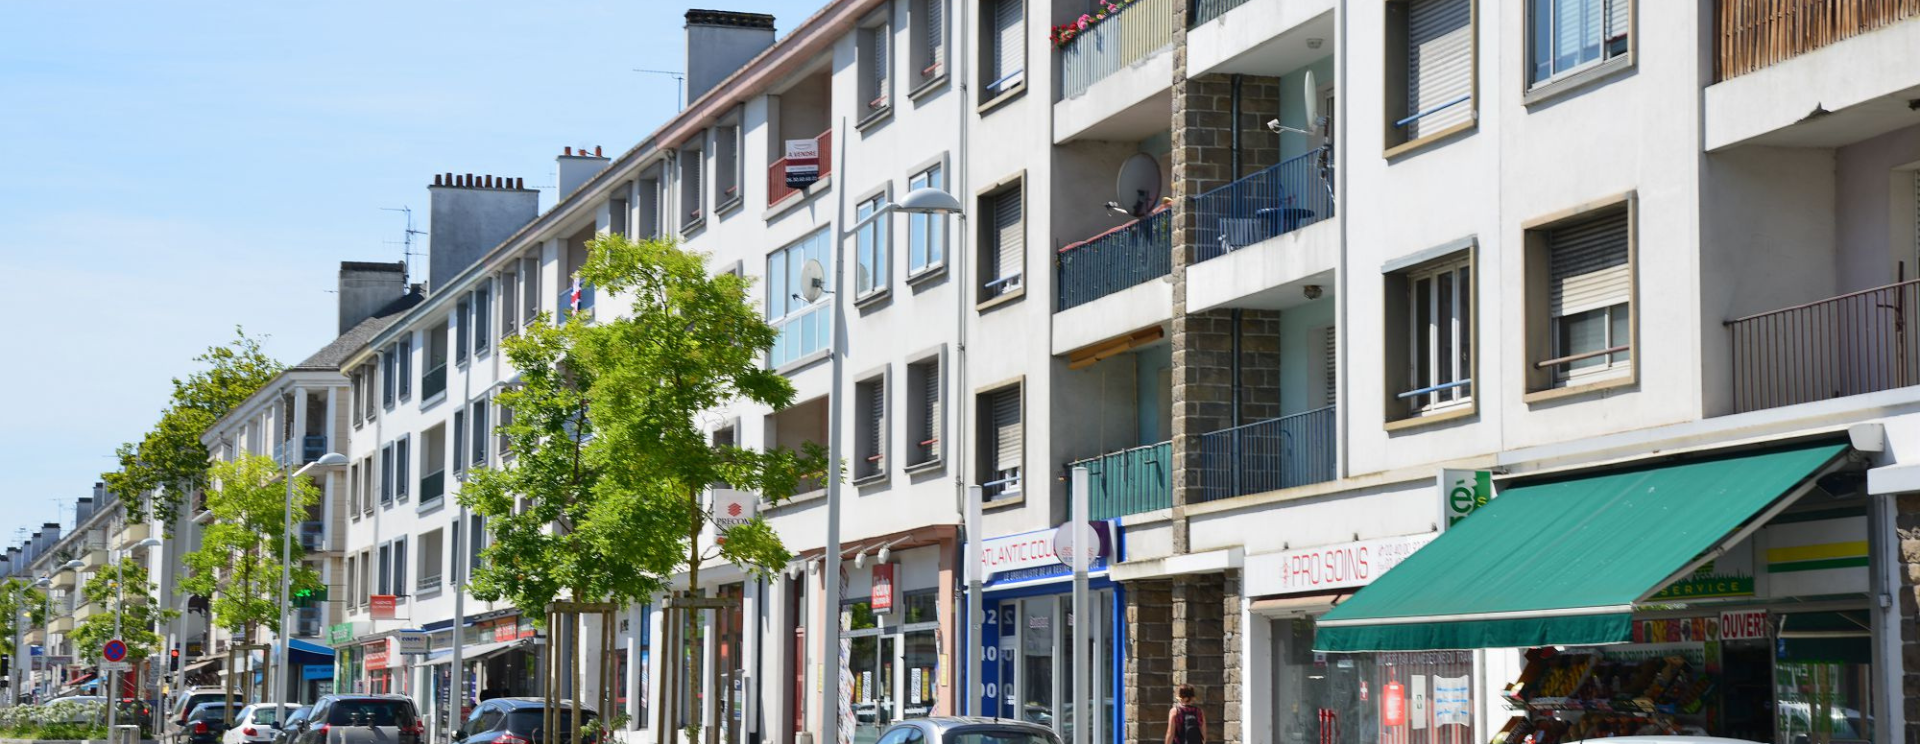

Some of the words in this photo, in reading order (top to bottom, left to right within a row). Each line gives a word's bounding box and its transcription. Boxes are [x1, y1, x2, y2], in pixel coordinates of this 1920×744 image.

[1292, 552, 1320, 587] PRO
[1325, 546, 1369, 583] SOINS
[1660, 581, 1740, 596] SERVICE
[1722, 611, 1767, 639] OUVERT
